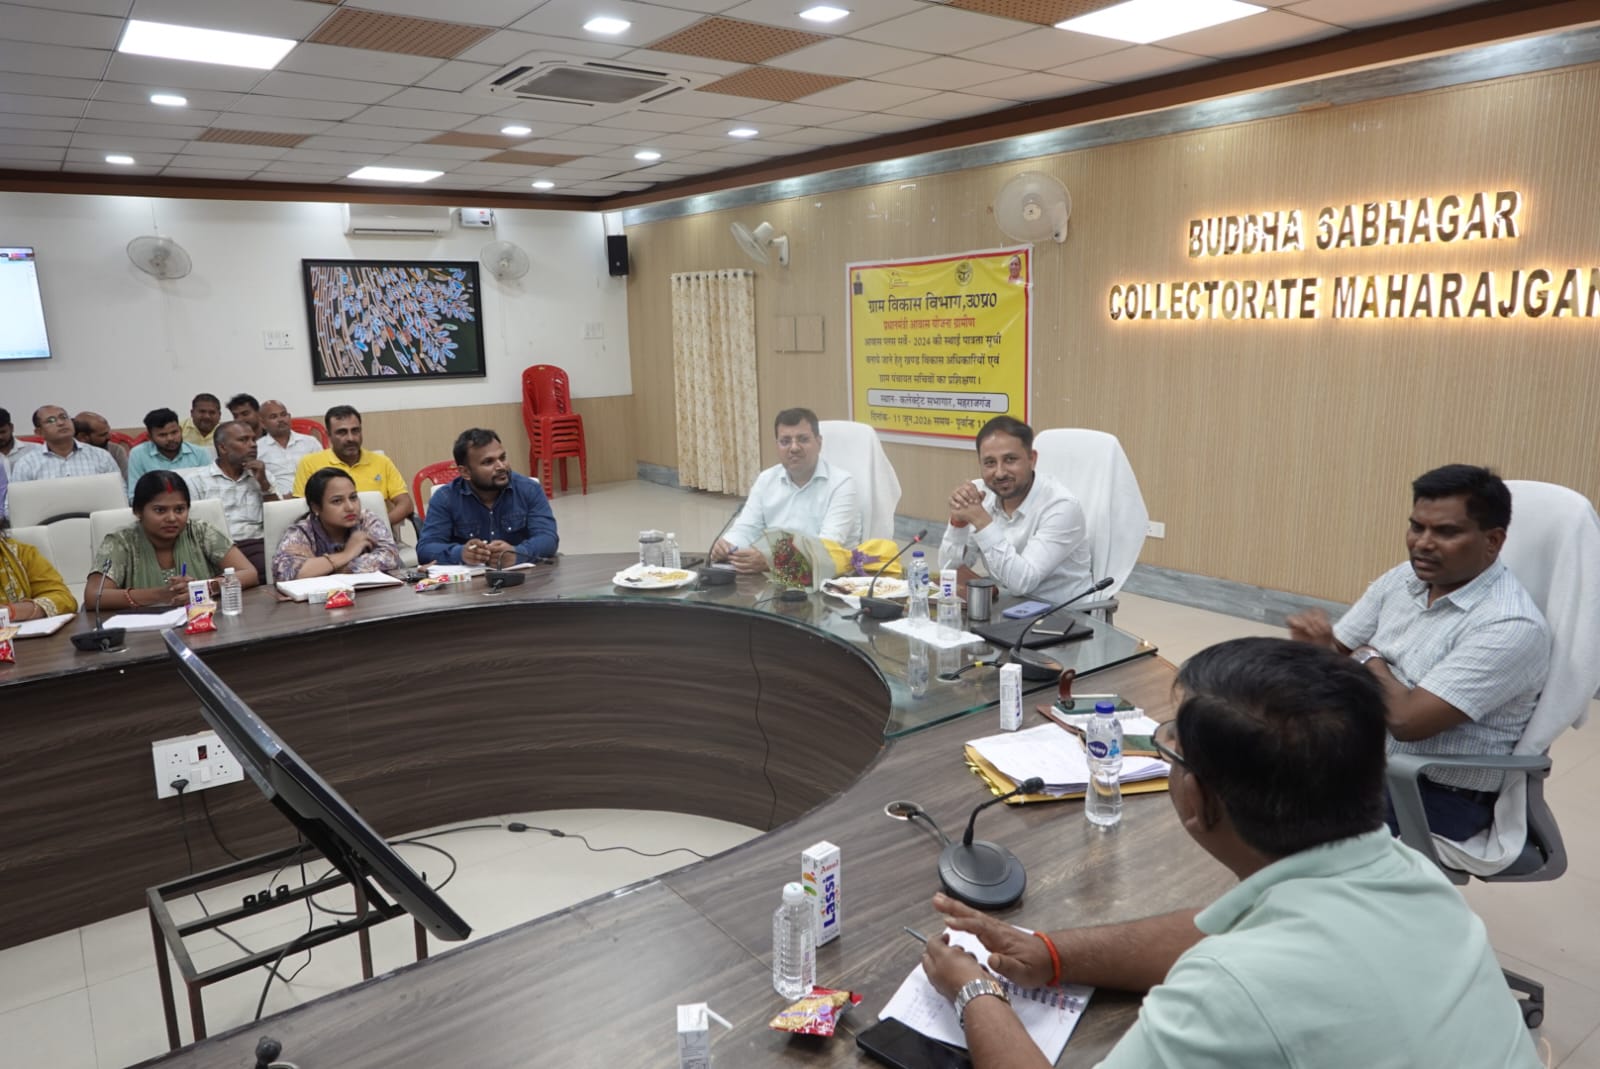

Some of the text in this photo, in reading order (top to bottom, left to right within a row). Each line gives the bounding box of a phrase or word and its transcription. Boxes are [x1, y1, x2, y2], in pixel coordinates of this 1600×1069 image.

[1189, 190, 1521, 258] BUDDHA SABHAGAR
[868, 299, 885, 313] ग्राम
[888, 294, 922, 312] विकास
[1109, 276, 1320, 321] COLLECTORATE
[913, 336, 931, 346] 2024
[823, 874, 836, 929] Lassi
